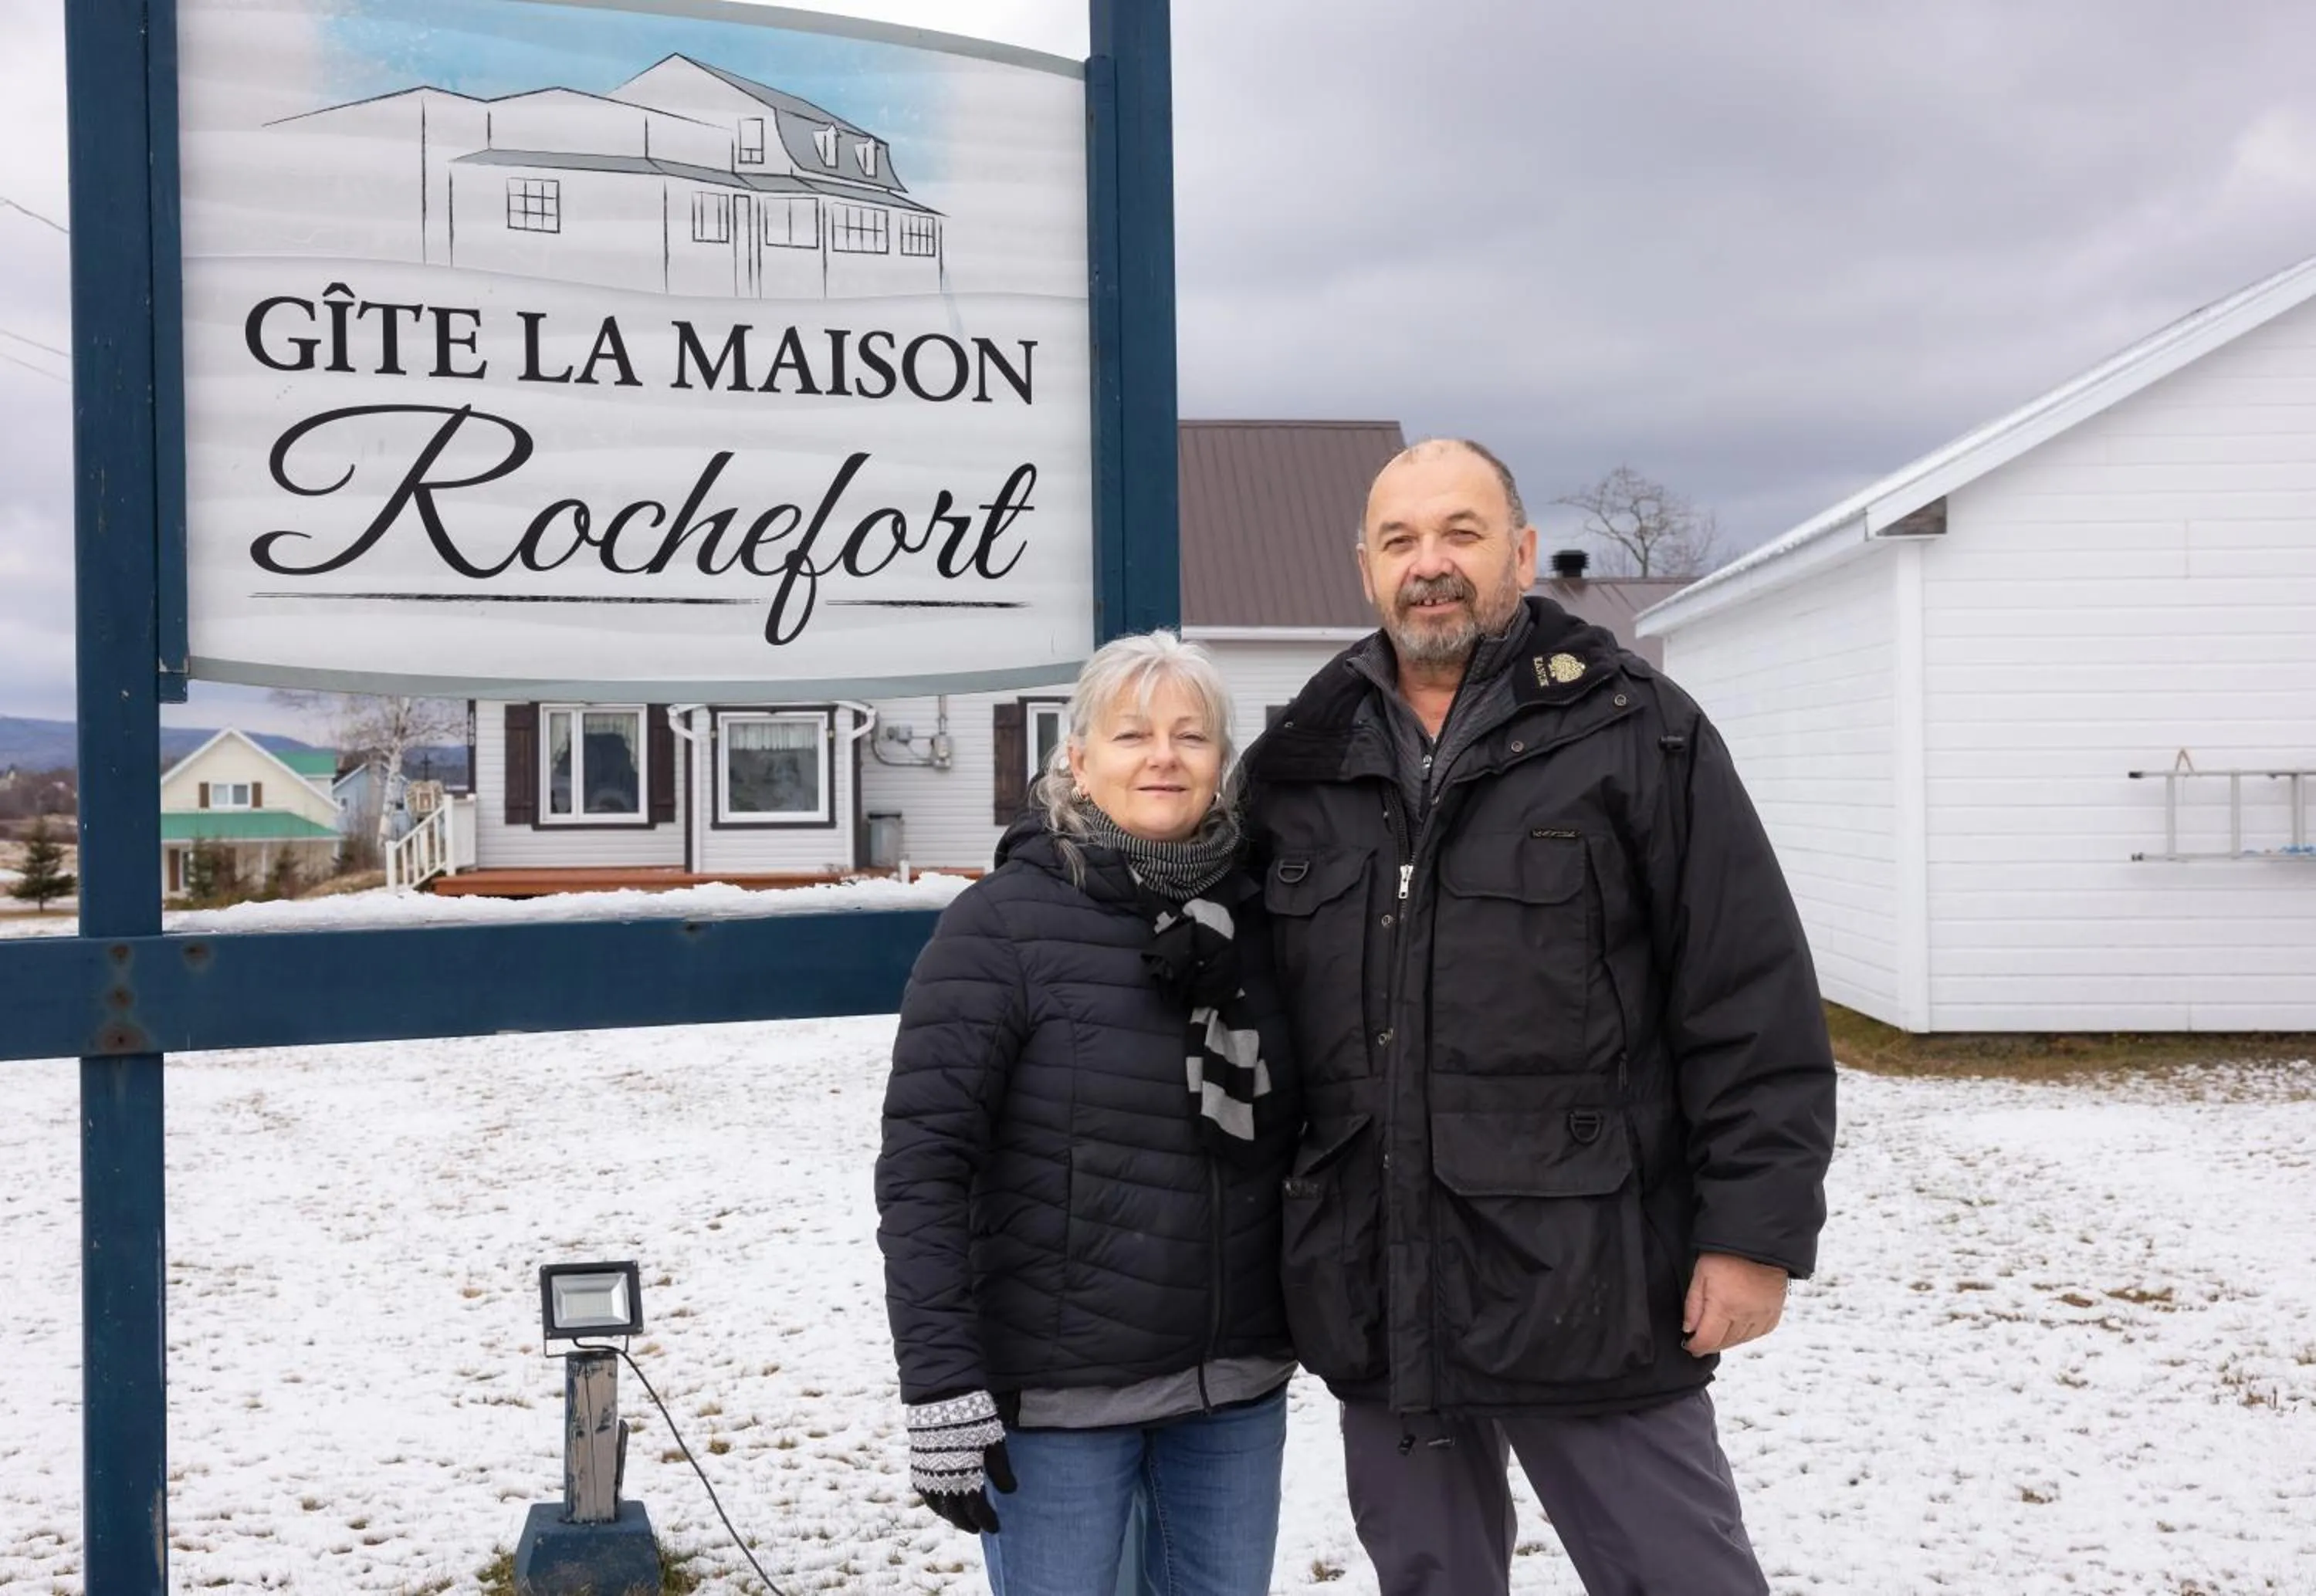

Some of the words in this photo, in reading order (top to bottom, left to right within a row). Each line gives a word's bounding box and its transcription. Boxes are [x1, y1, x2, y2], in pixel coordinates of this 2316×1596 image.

[245, 282, 487, 379] GÎTE
[517, 312, 642, 387] LA
[672, 320, 1038, 405] MAISON
[250, 404, 1037, 646] Rochefort
